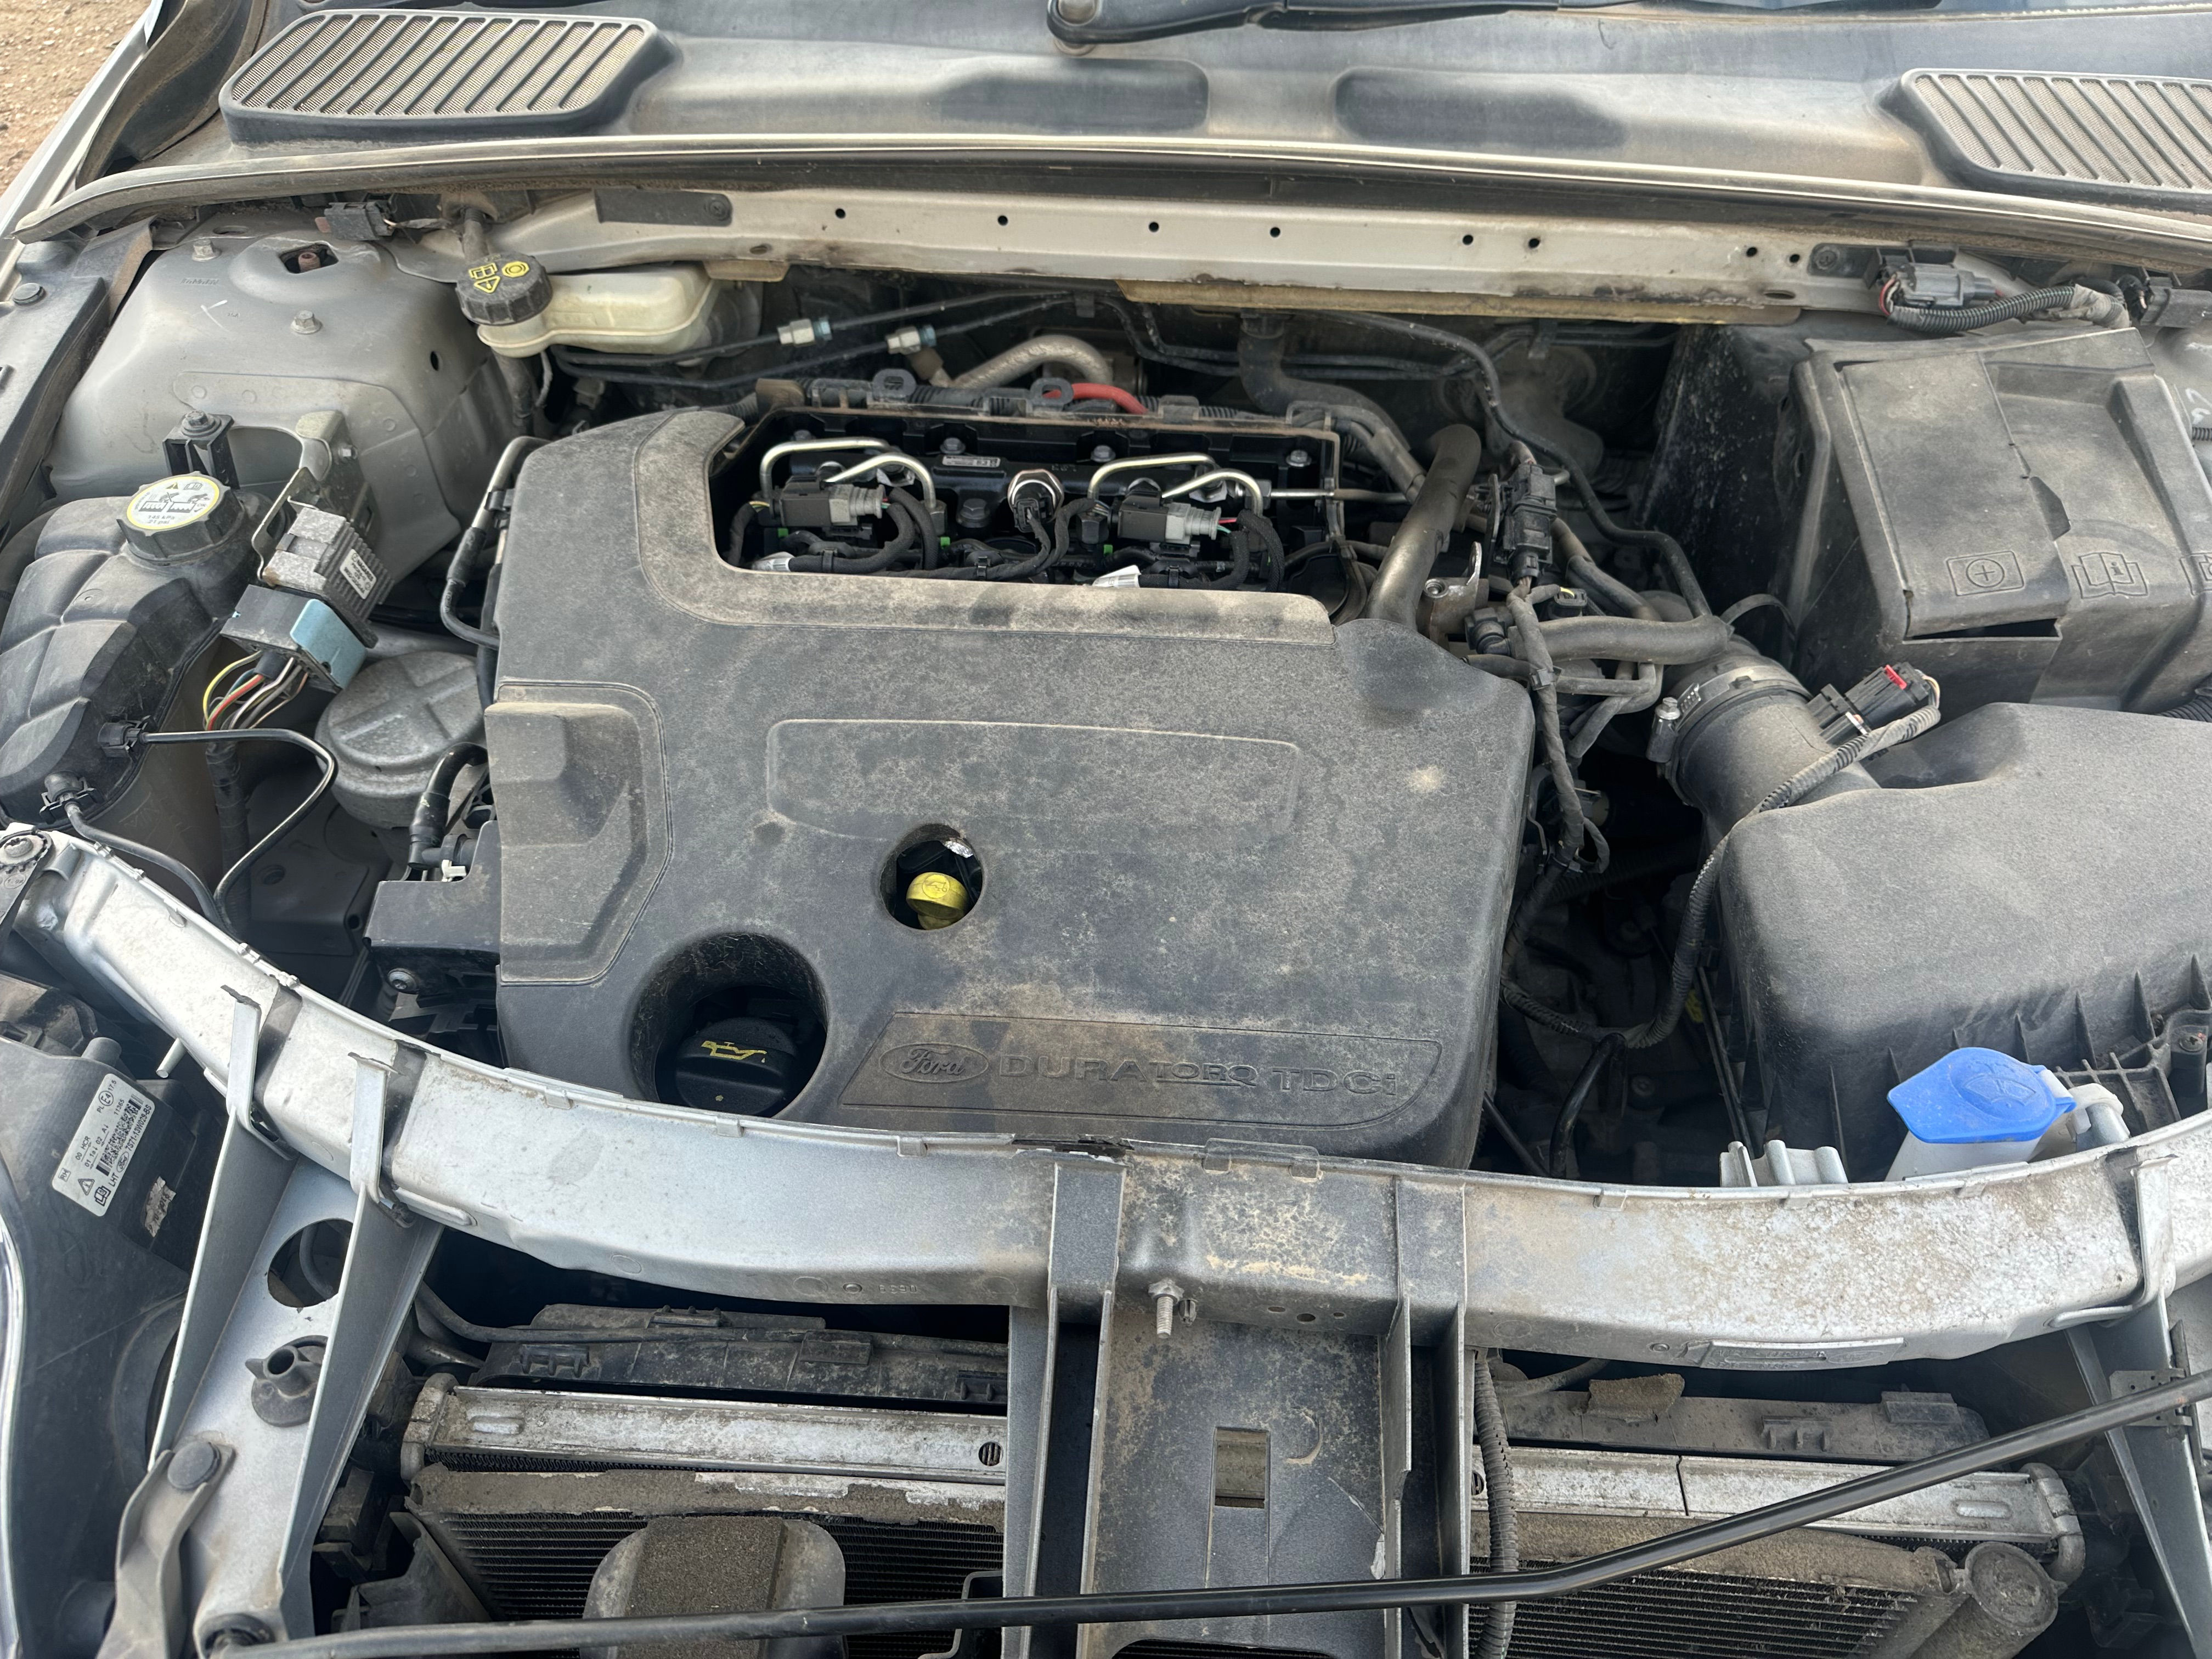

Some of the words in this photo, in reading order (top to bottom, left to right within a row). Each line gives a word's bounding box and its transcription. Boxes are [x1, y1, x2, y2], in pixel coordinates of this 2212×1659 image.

[899, 1047, 966, 1076] Ford
[999, 1054, 1259, 1086] DURATORQ
[1271, 1066, 1397, 1096] TDCi
[100, 1093, 112, 1105] E4
[97, 1105, 105, 1114] PL
[81, 1136, 91, 1150] HCR
[84, 1159, 92, 1167] 01
[95, 1136, 103, 1145] 02
[60, 1169, 69, 1180] RH
[109, 1172, 119, 1187] LHT
[117, 1155, 128, 1171] Ford
